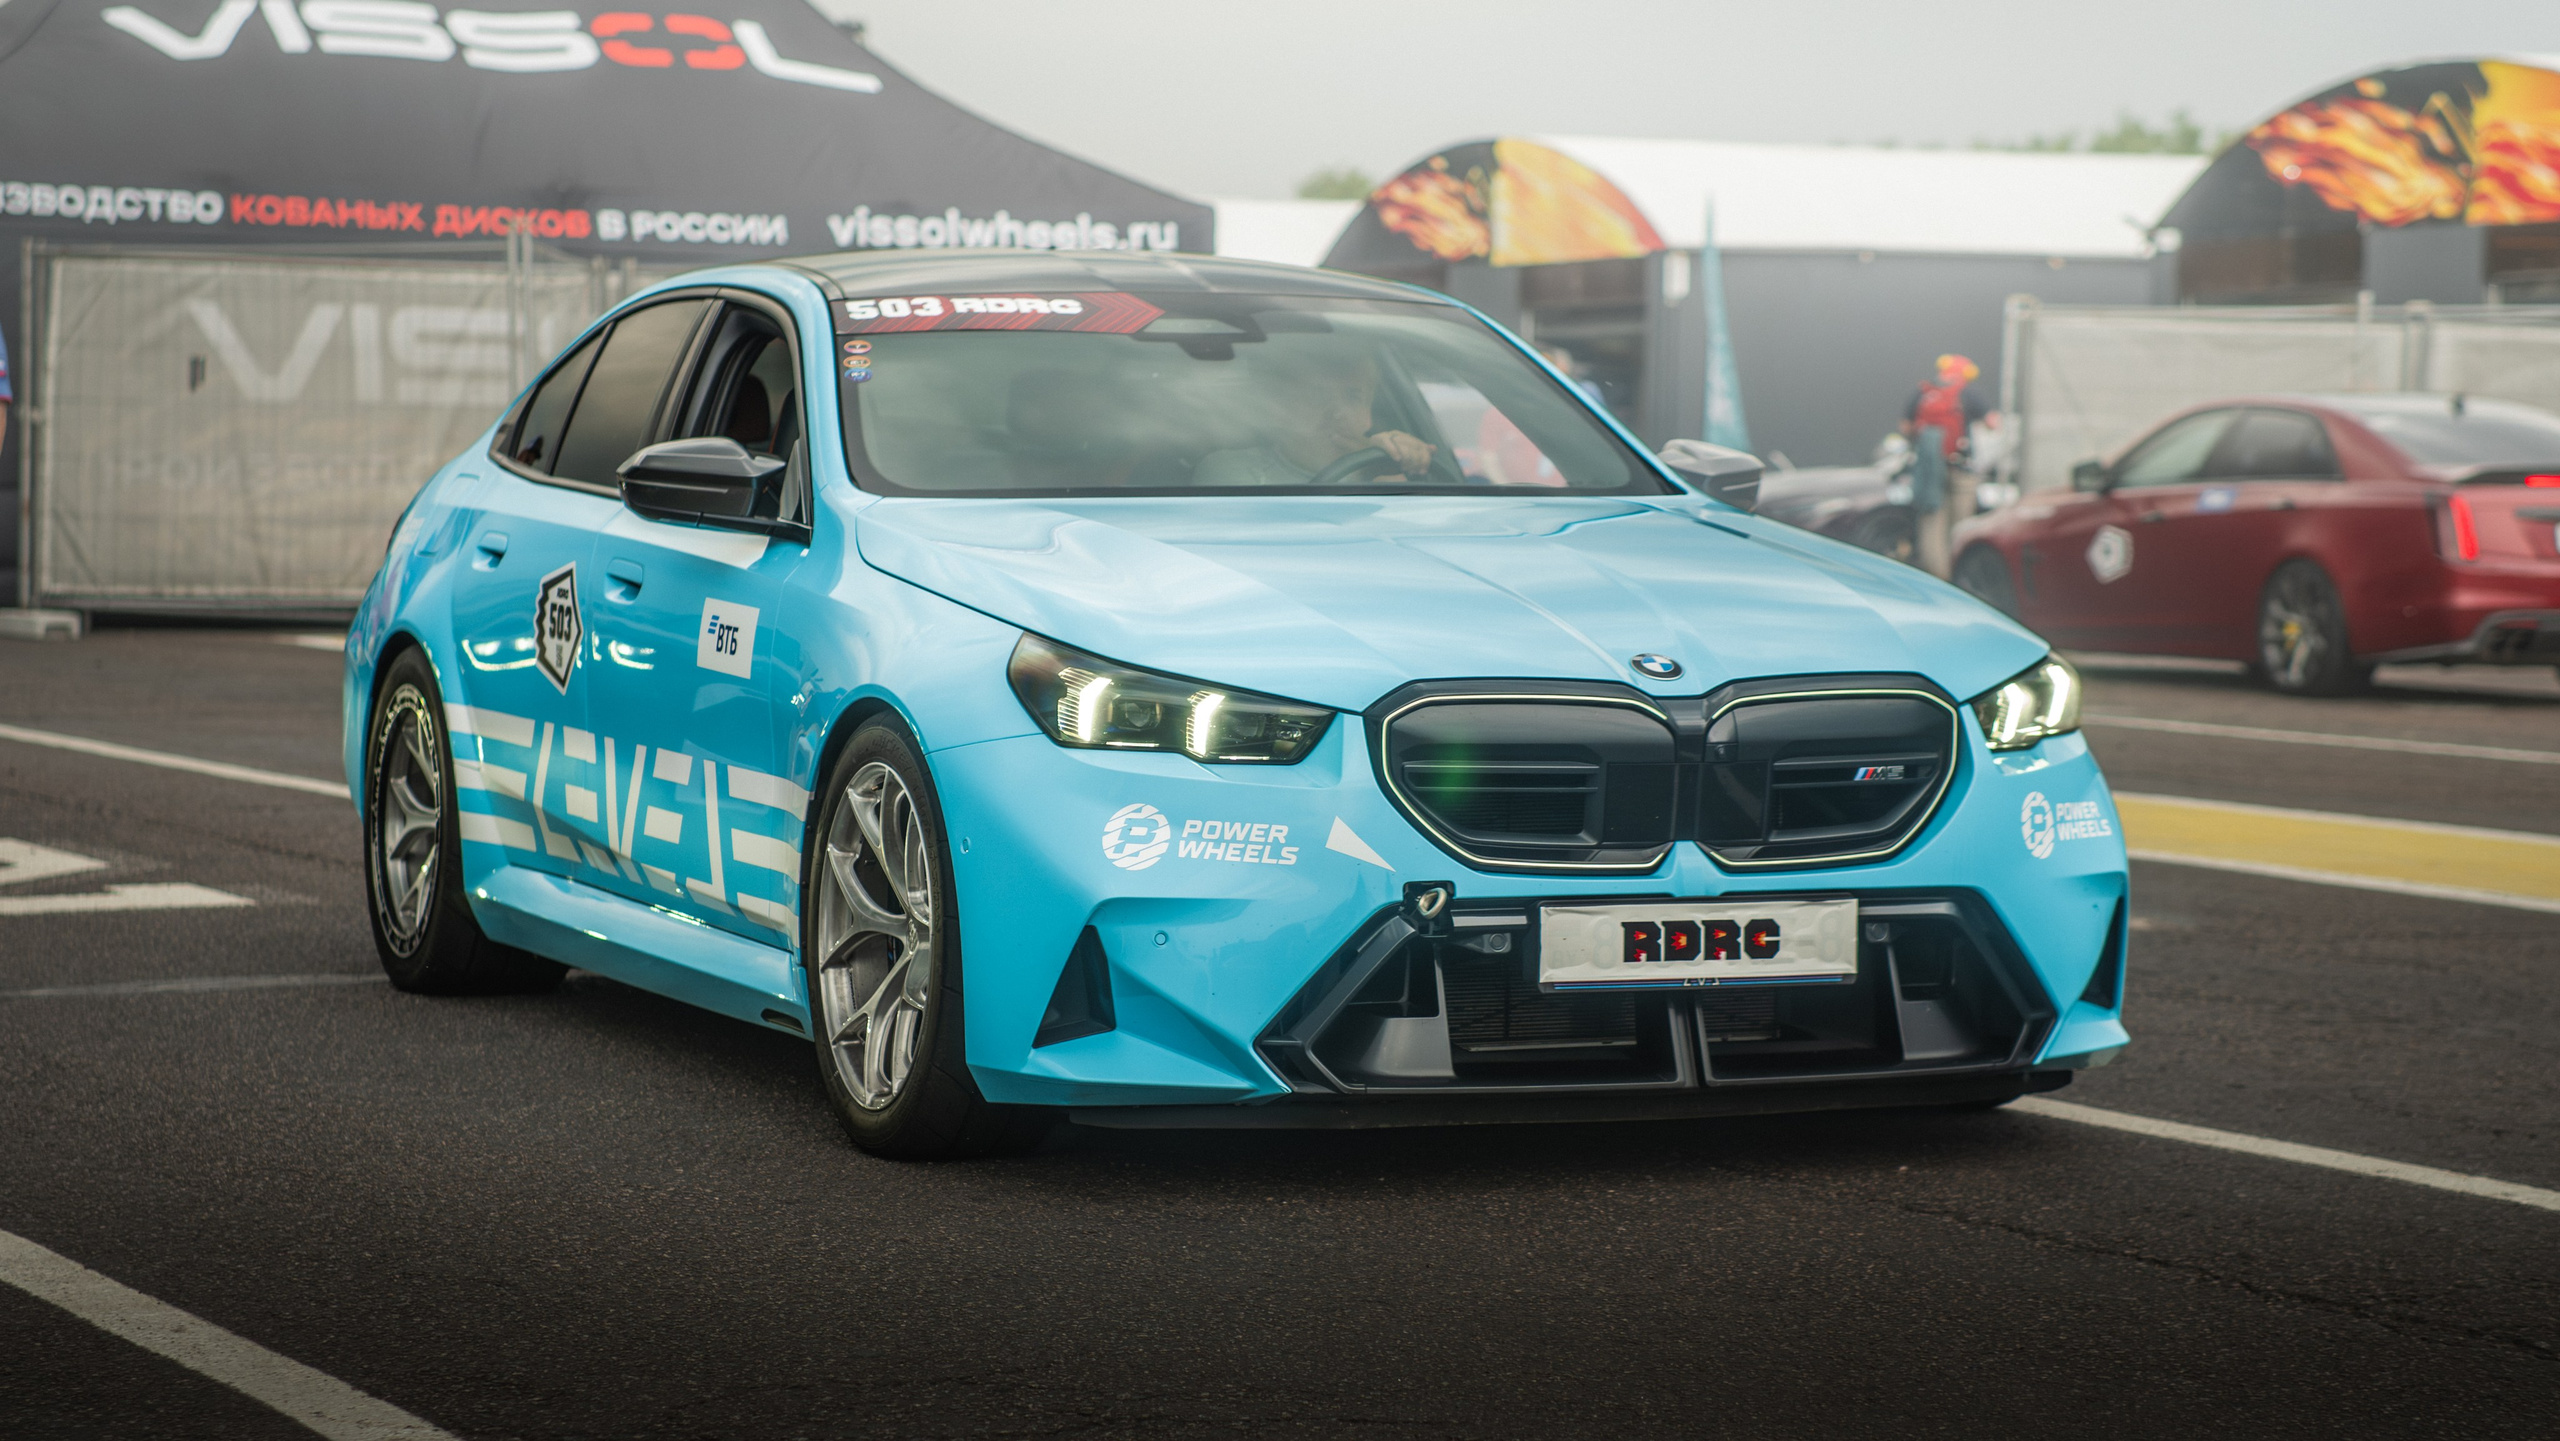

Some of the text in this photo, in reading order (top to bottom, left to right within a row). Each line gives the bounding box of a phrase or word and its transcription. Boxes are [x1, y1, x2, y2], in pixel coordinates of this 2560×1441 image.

[0, 181, 789, 246] ЗВОДСТВО КОВАНЫХ ДИСКОВ В РОССИИ
[827, 204, 1178, 250] vissolwheels.ru
[846, 297, 1084, 320] 503 RDRC
[549, 602, 572, 642] 503
[715, 623, 739, 656] ВТБ
[2056, 801, 2101, 821] POWER
[1182, 819, 1289, 844] POWER
[2056, 819, 2112, 841] WHEELS
[1177, 840, 1300, 866] WHEELS
[1621, 918, 1780, 963] RDRC
